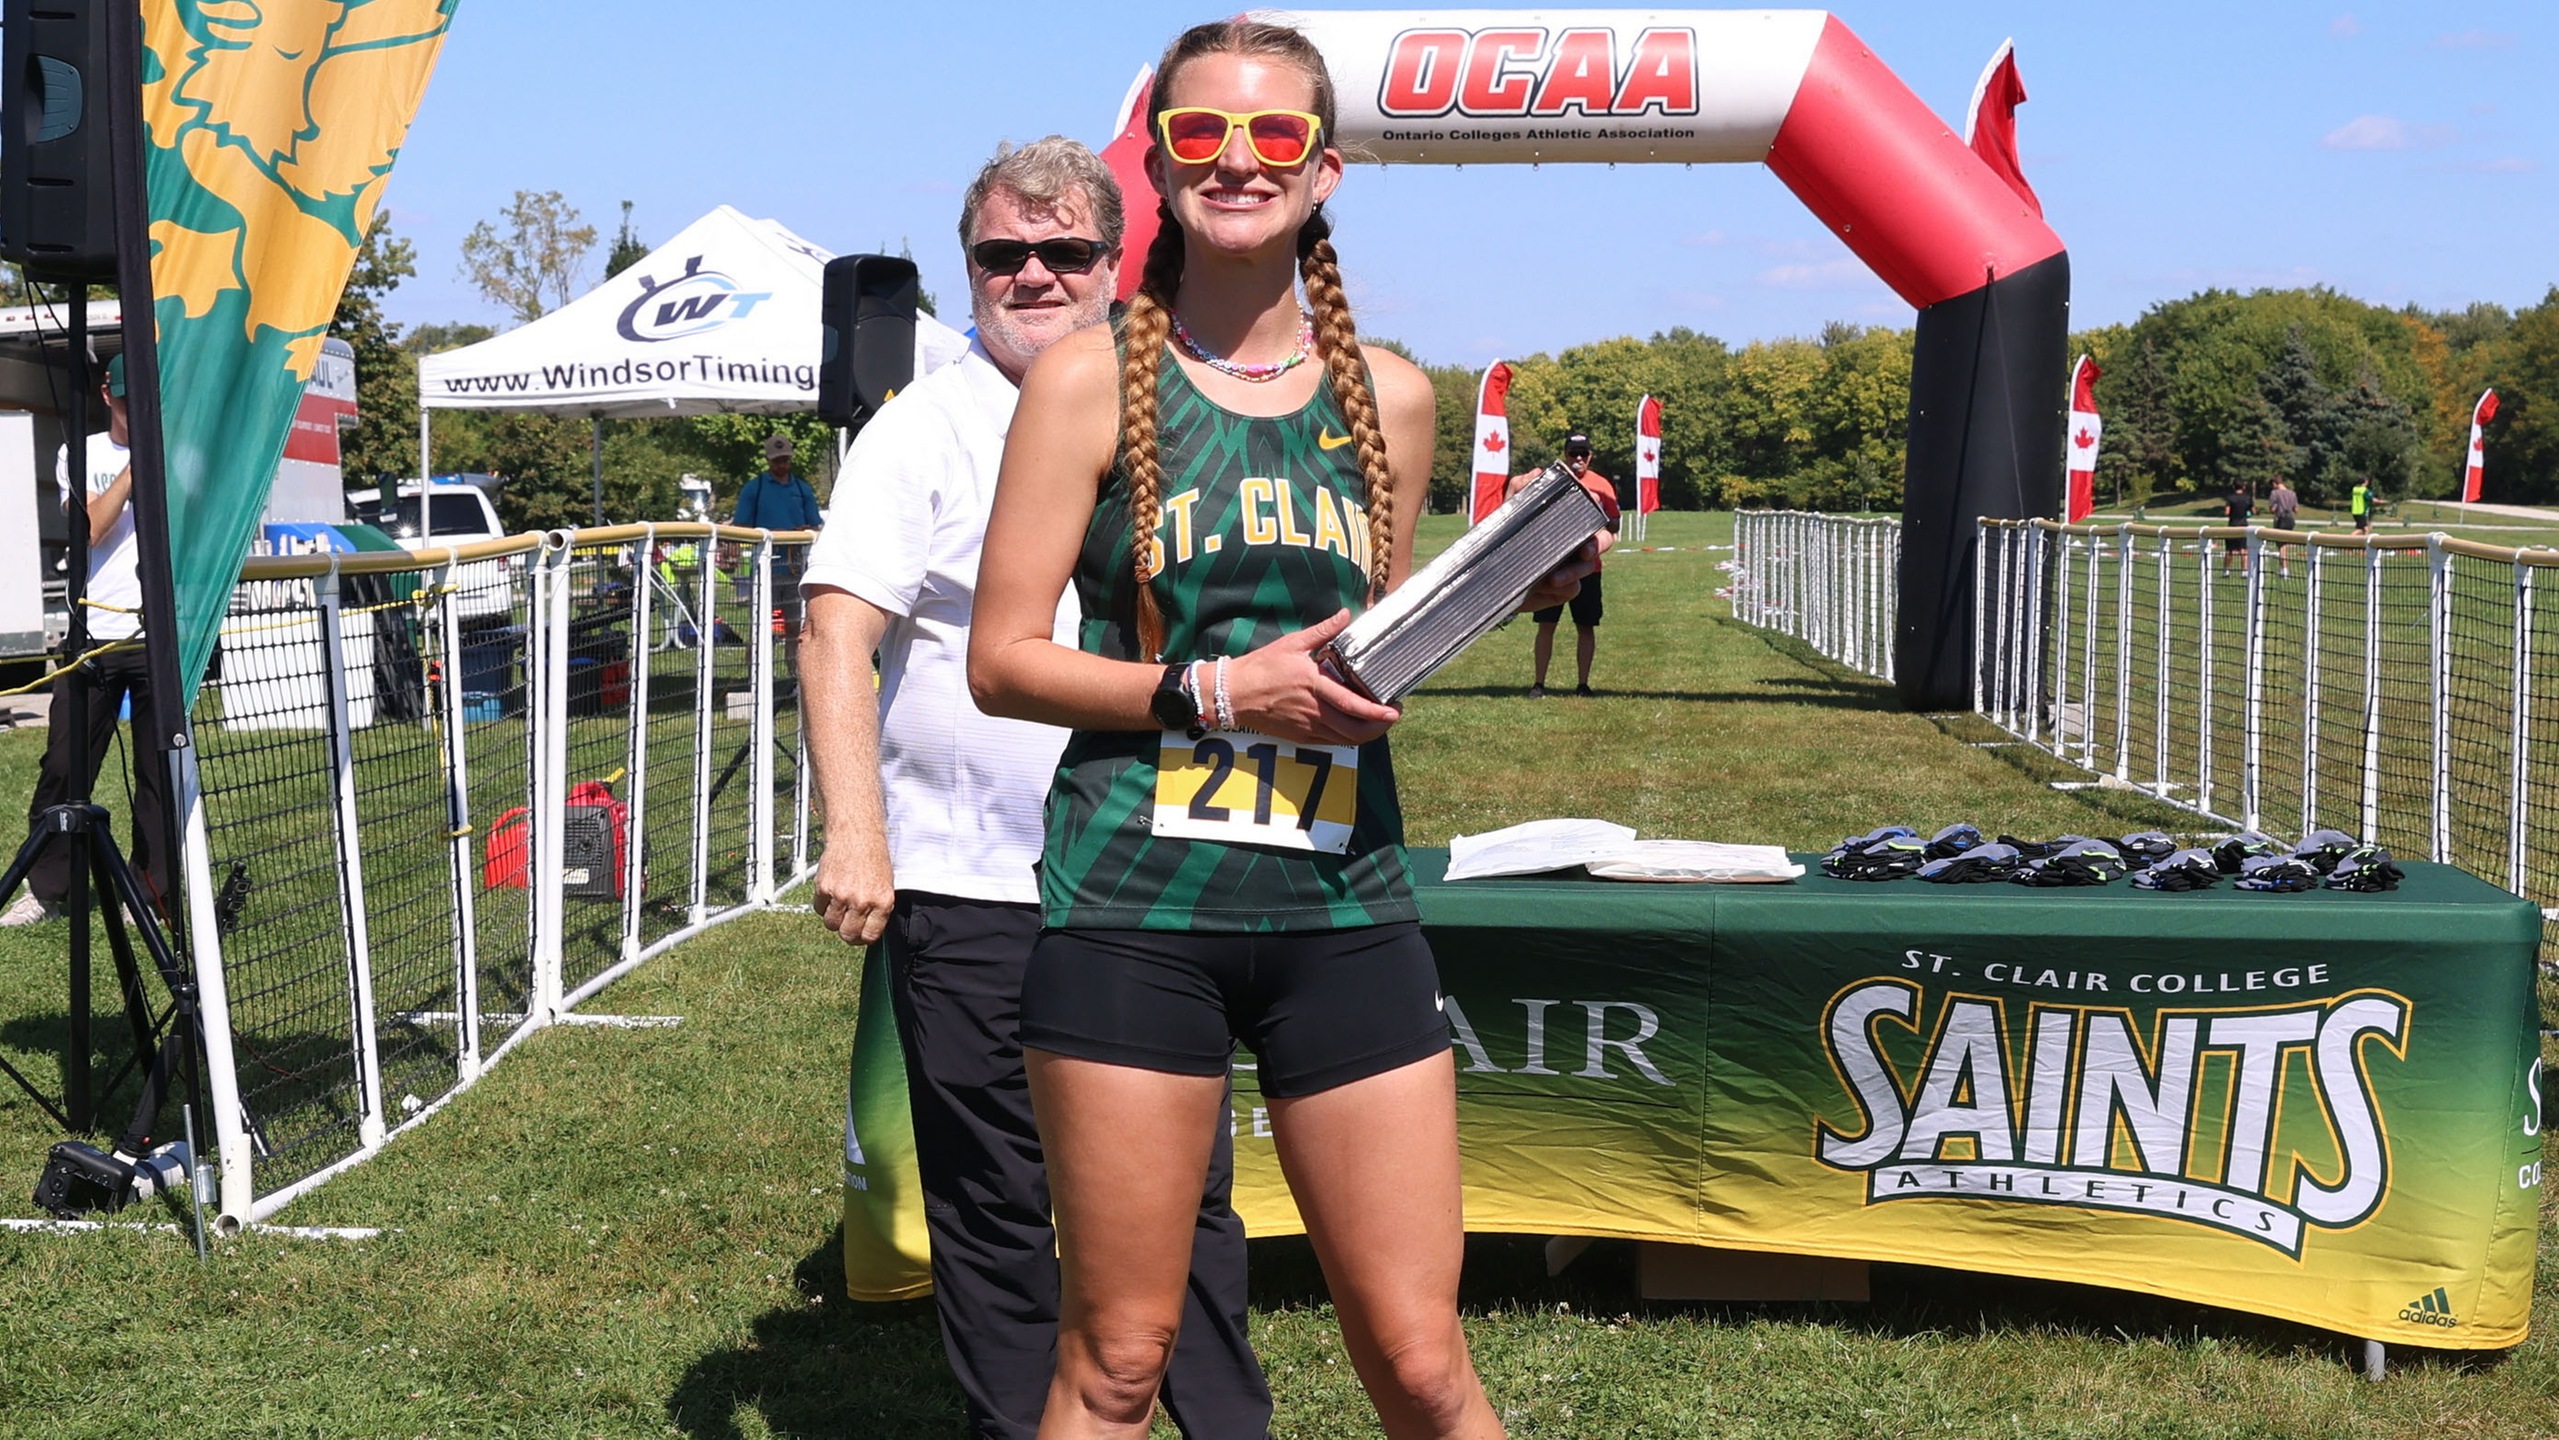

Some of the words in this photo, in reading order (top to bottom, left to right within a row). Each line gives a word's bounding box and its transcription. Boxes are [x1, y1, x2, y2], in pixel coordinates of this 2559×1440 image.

[1380, 28, 1699, 117] OCAA
[1382, 129, 1444, 141] Ontario
[1449, 129, 1521, 142] Colleges
[1526, 128, 1591, 140] Athletic
[1598, 127, 1695, 139] Association
[653, 292, 773, 327] WT
[1187, 738, 1333, 832] 217
[1901, 949, 1962, 977] ST.
[1983, 962, 2109, 992] CLAIR
[2129, 963, 2330, 993] COLLEGE
[1816, 980, 2406, 1228] SAINTS
[1896, 1170, 2276, 1232] ATHLETICS
[2398, 1309, 2458, 1329] adidas
